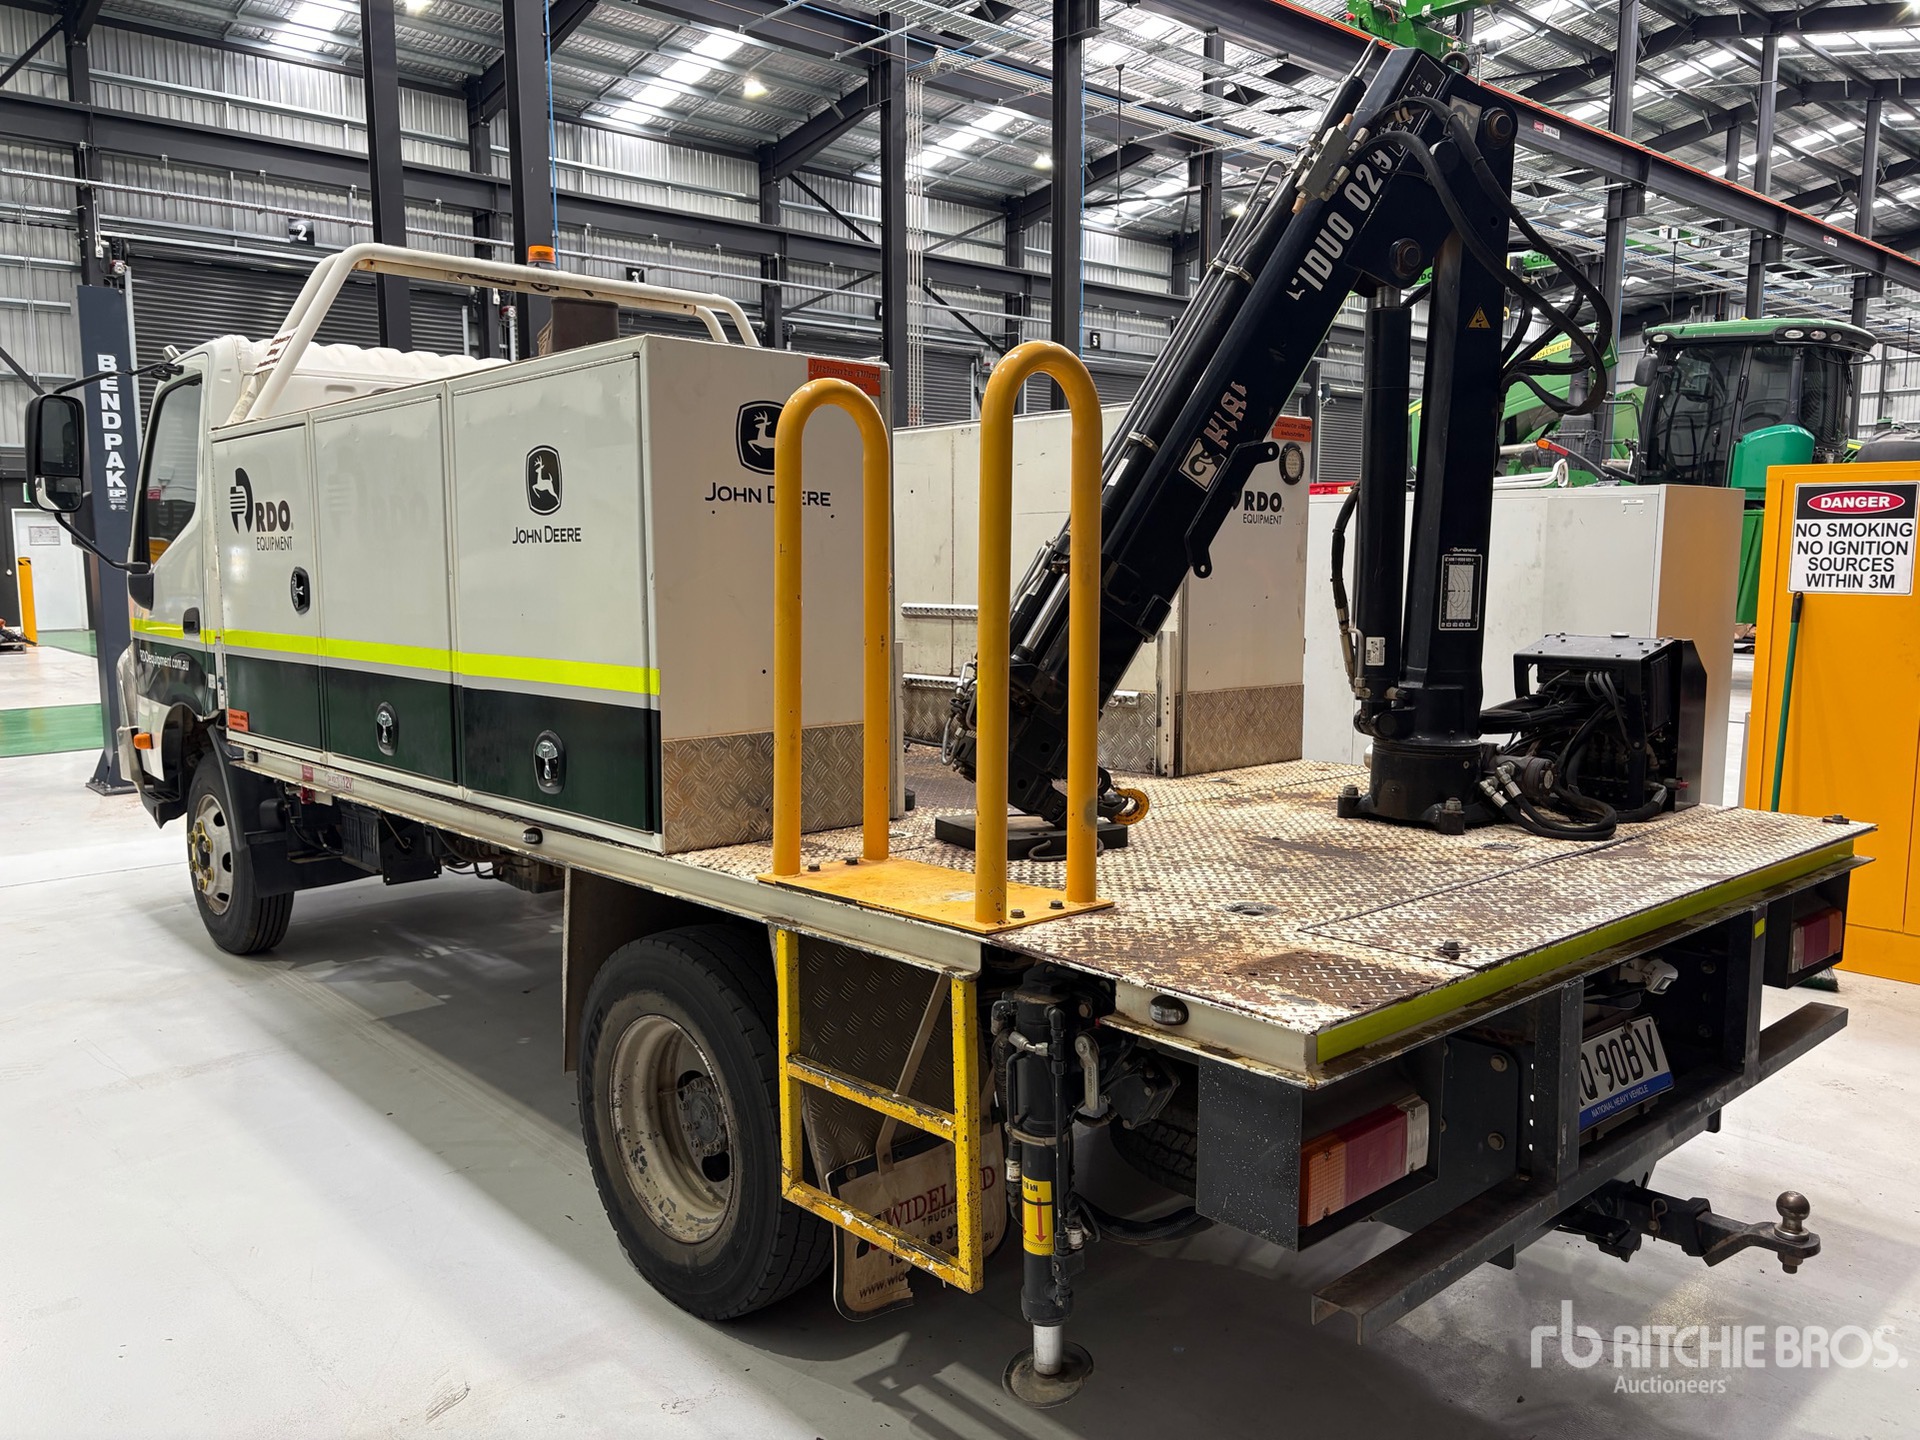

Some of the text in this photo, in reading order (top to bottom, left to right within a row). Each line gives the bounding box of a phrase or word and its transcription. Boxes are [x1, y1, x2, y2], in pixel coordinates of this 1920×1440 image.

[297, 224, 308, 242] 2
[98, 354, 127, 488] BENDPAK
[705, 482, 762, 504] JOHN
[1244, 490, 1282, 513] RDO
[1820, 496, 1890, 508] DANGER
[255, 500, 291, 532] RDO
[1243, 513, 1282, 525] EQUIPMENT
[512, 525, 582, 544] JOHN DEERE
[1796, 522, 1913, 538] NO SMOKING
[256, 536, 292, 551] EQUIPMENT
[1797, 541, 1909, 556] NO IGNITION
[1808, 557, 1895, 572] SOURCES
[1806, 573, 1895, 589] WITHIN 3M
[1591, 1084, 1649, 1118] NATIONAL HEAVY VEHICLE
[883, 1165, 996, 1228] WIDELD
